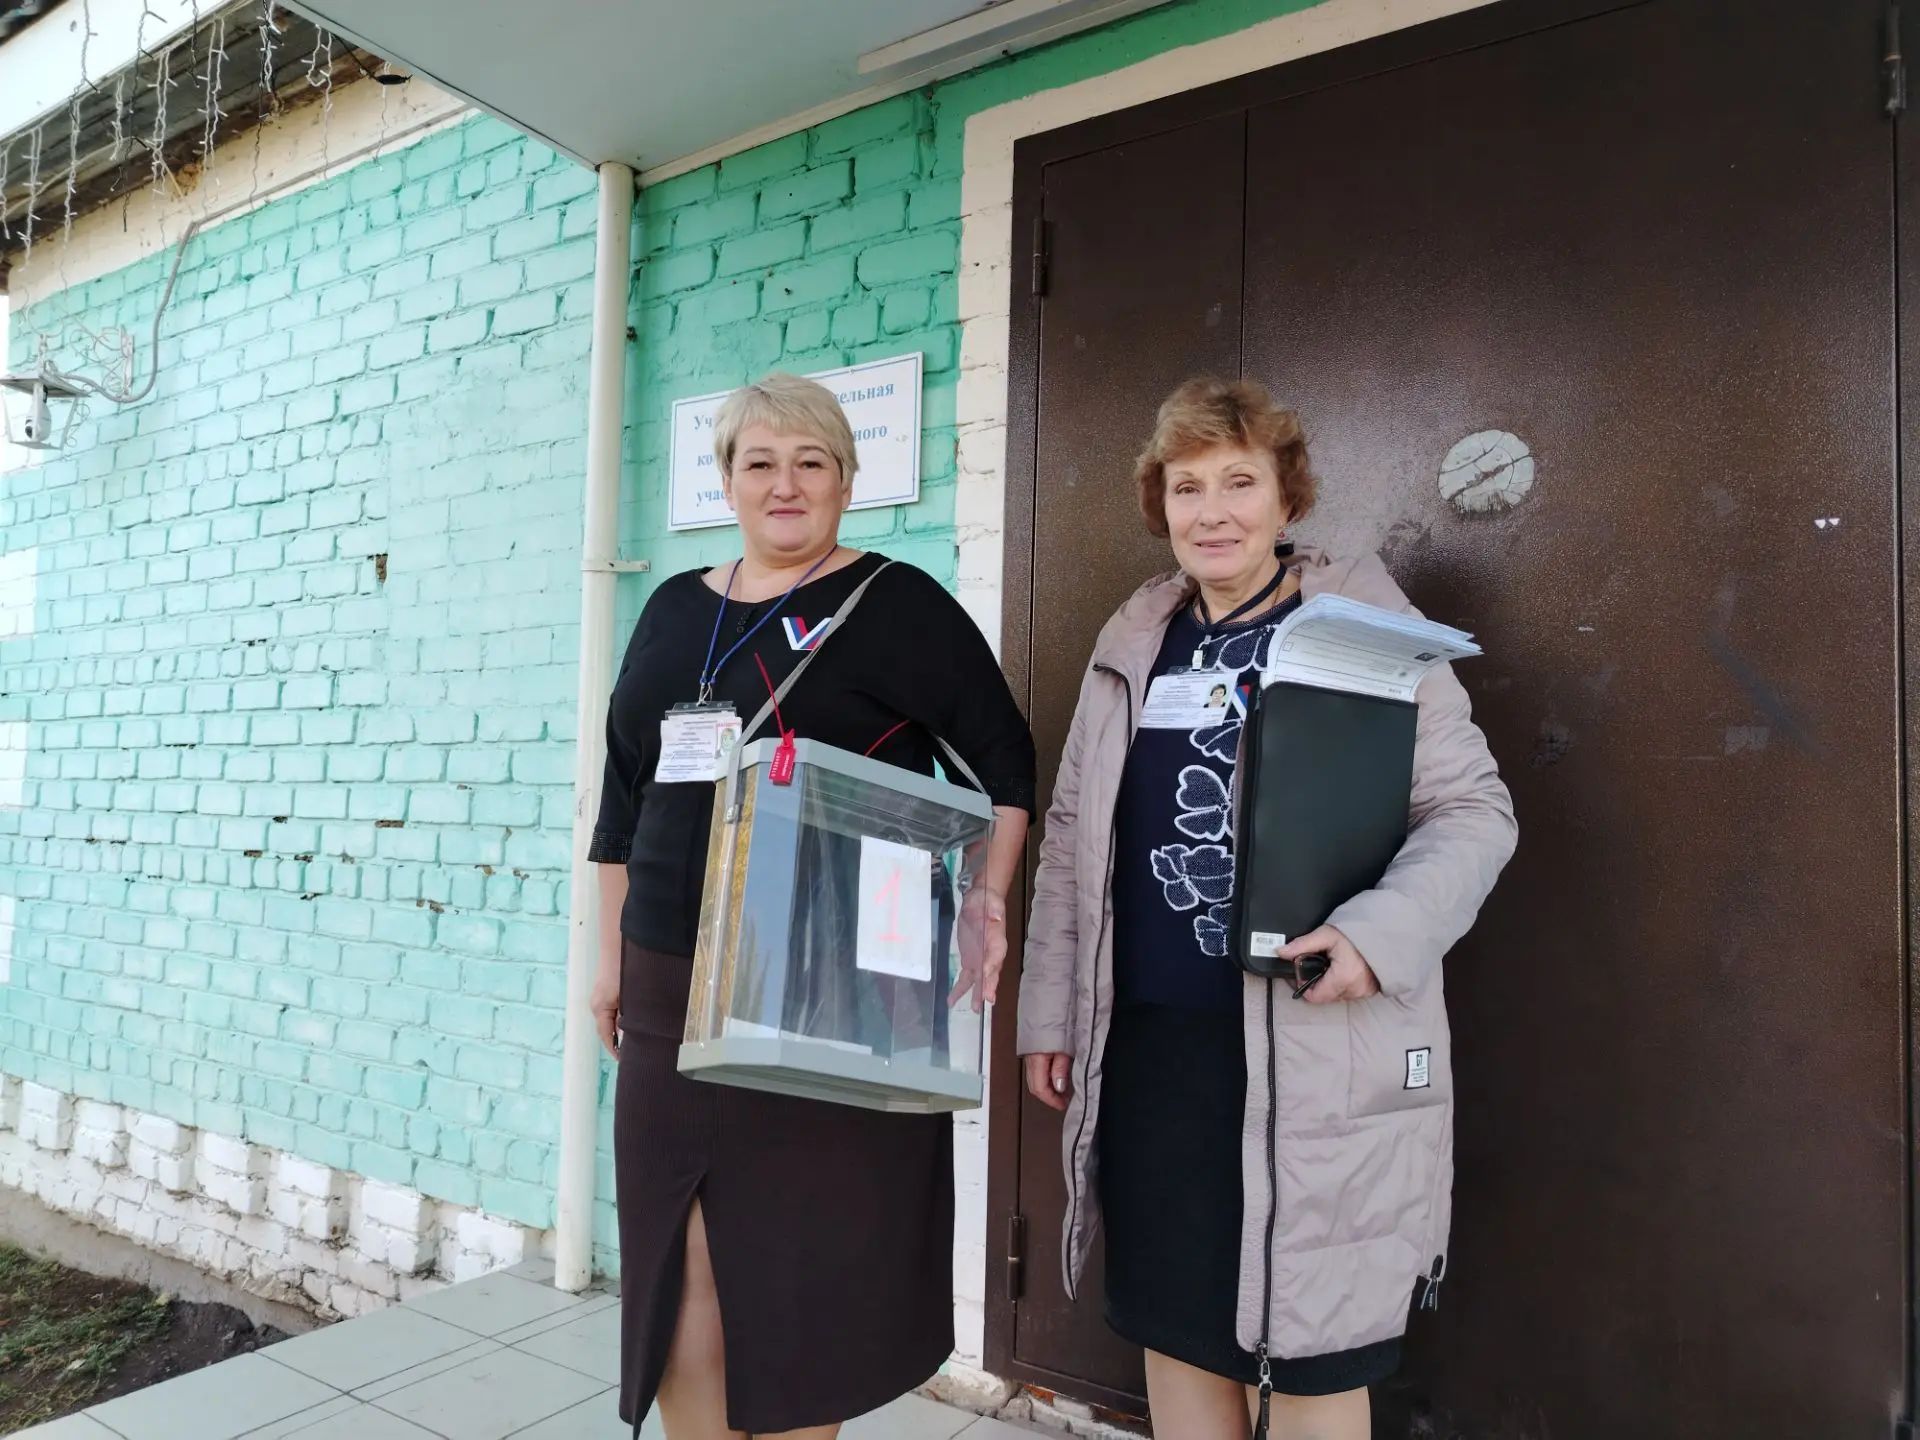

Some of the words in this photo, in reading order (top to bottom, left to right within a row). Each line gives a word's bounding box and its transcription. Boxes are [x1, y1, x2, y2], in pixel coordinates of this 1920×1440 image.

[694, 414, 713, 430] Уч
[697, 454, 713, 467] ко
[853, 425, 888, 441] ного
[874, 866, 912, 942] 1
